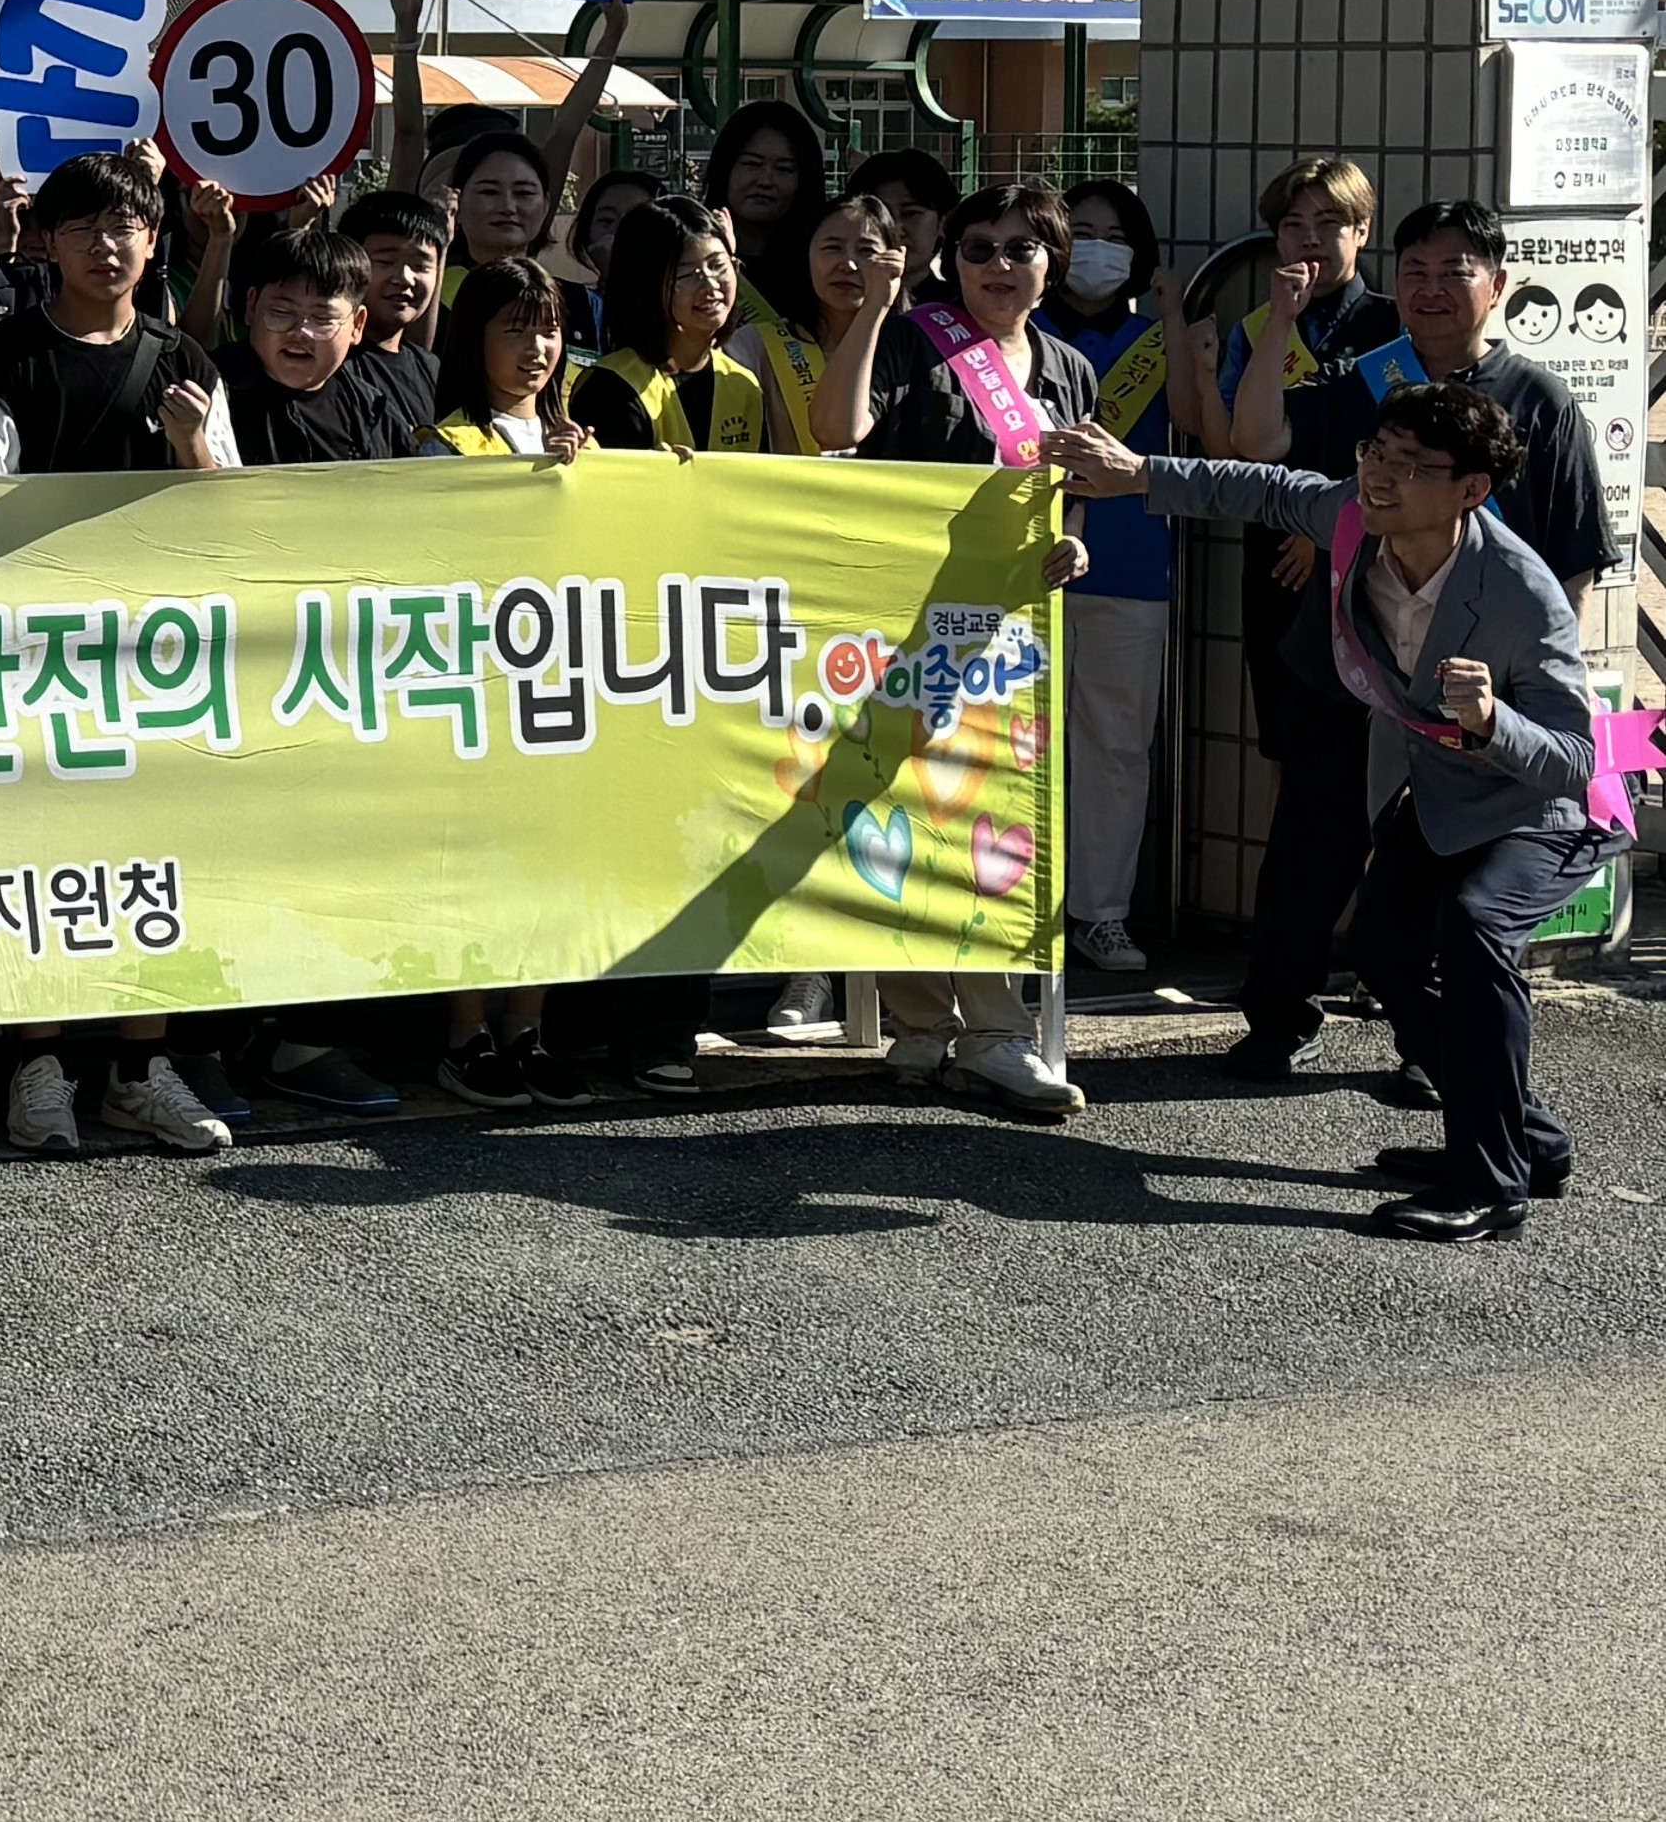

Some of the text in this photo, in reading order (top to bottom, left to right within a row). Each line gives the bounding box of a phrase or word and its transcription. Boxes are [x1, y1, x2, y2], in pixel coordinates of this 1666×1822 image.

[189, 32, 334, 157] 30
[1505, 237, 1625, 265] 교육환경보호구역
[1602, 485, 1630, 501] 00M
[933, 611, 1002, 636] 경남교육
[281, 586, 823, 748] 시작입니다.
